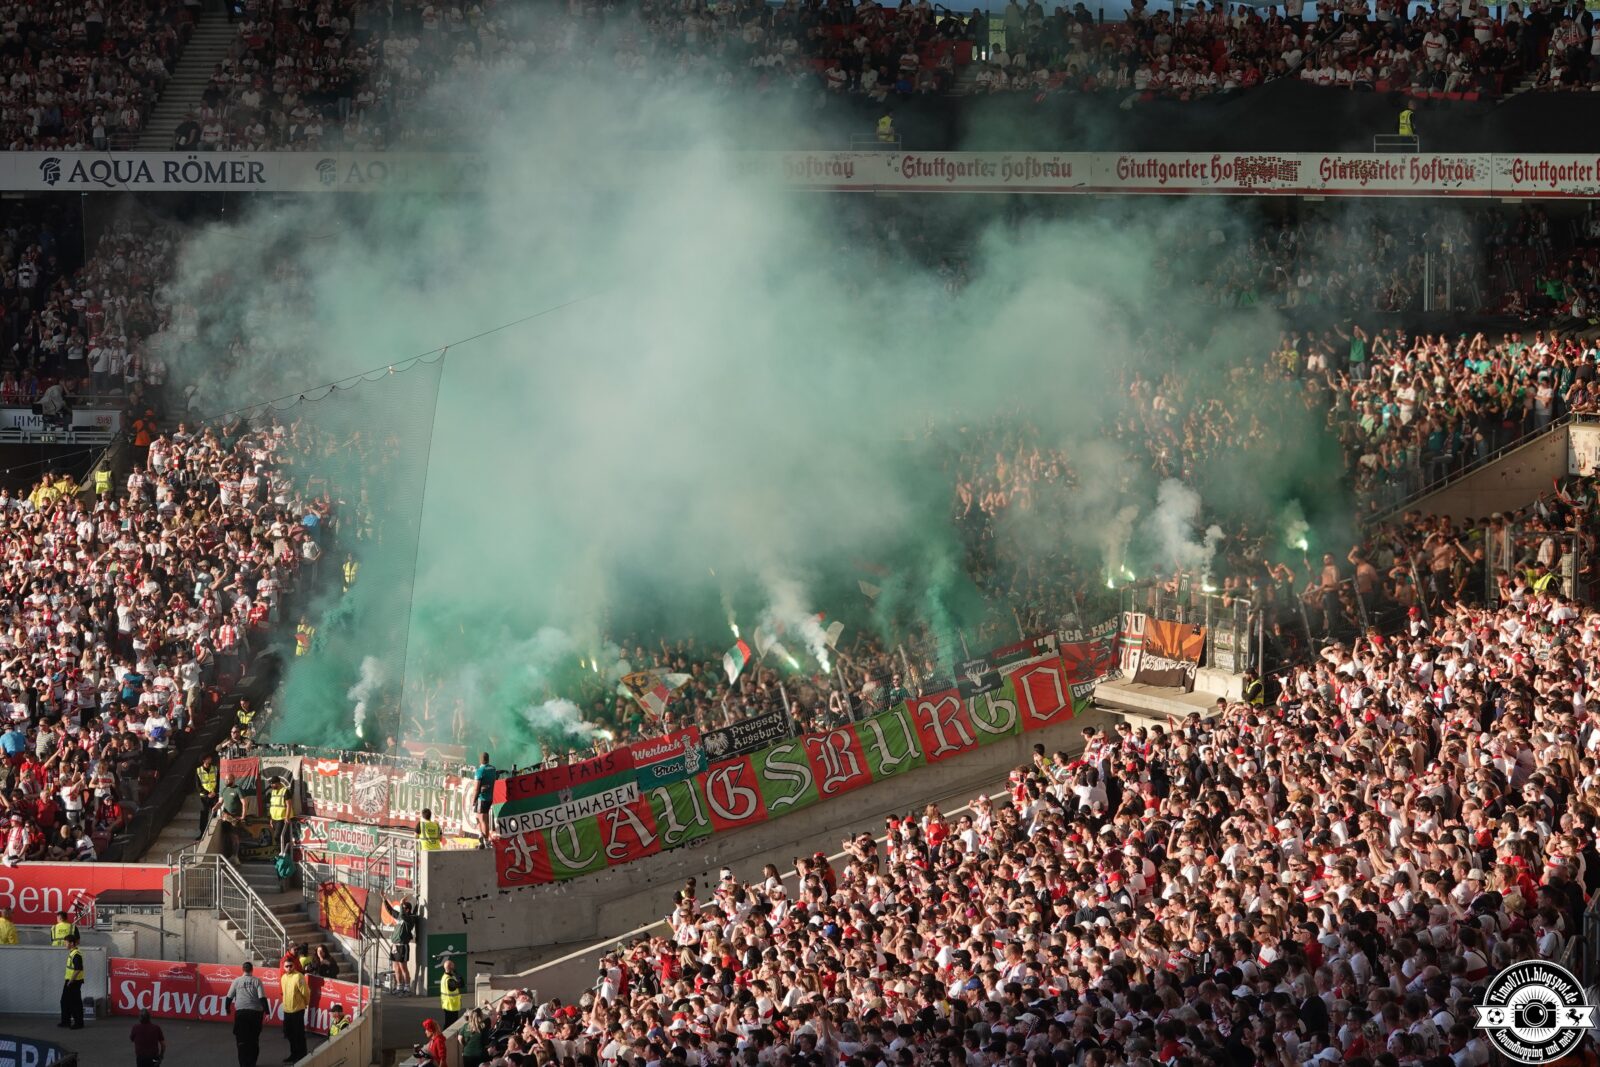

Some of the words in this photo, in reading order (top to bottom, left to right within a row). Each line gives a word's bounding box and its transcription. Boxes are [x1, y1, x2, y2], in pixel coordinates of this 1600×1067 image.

[69, 160, 155, 187] AQUA
[164, 155, 266, 185] RÖMER
[902, 155, 995, 184] Stuttgarter
[1001, 157, 1072, 180] Hofbräu
[1116, 155, 1207, 184] Stuttgarter
[1320, 156, 1406, 186] Stuttgarter
[1410, 157, 1475, 185] Hofbräu
[1512, 158, 1593, 188] Stuttgarter
[1058, 629, 1084, 642] FCA
[1091, 616, 1119, 638] FANS
[506, 775, 546, 797] FCA
[567, 756, 616, 783] FANS
[653, 761, 684, 779] Bros.
[497, 787, 636, 835] NORDSCHWABEN
[329, 827, 376, 848] CONCORDIA
[504, 821, 599, 881] FC
[0, 876, 87, 914] Benz
